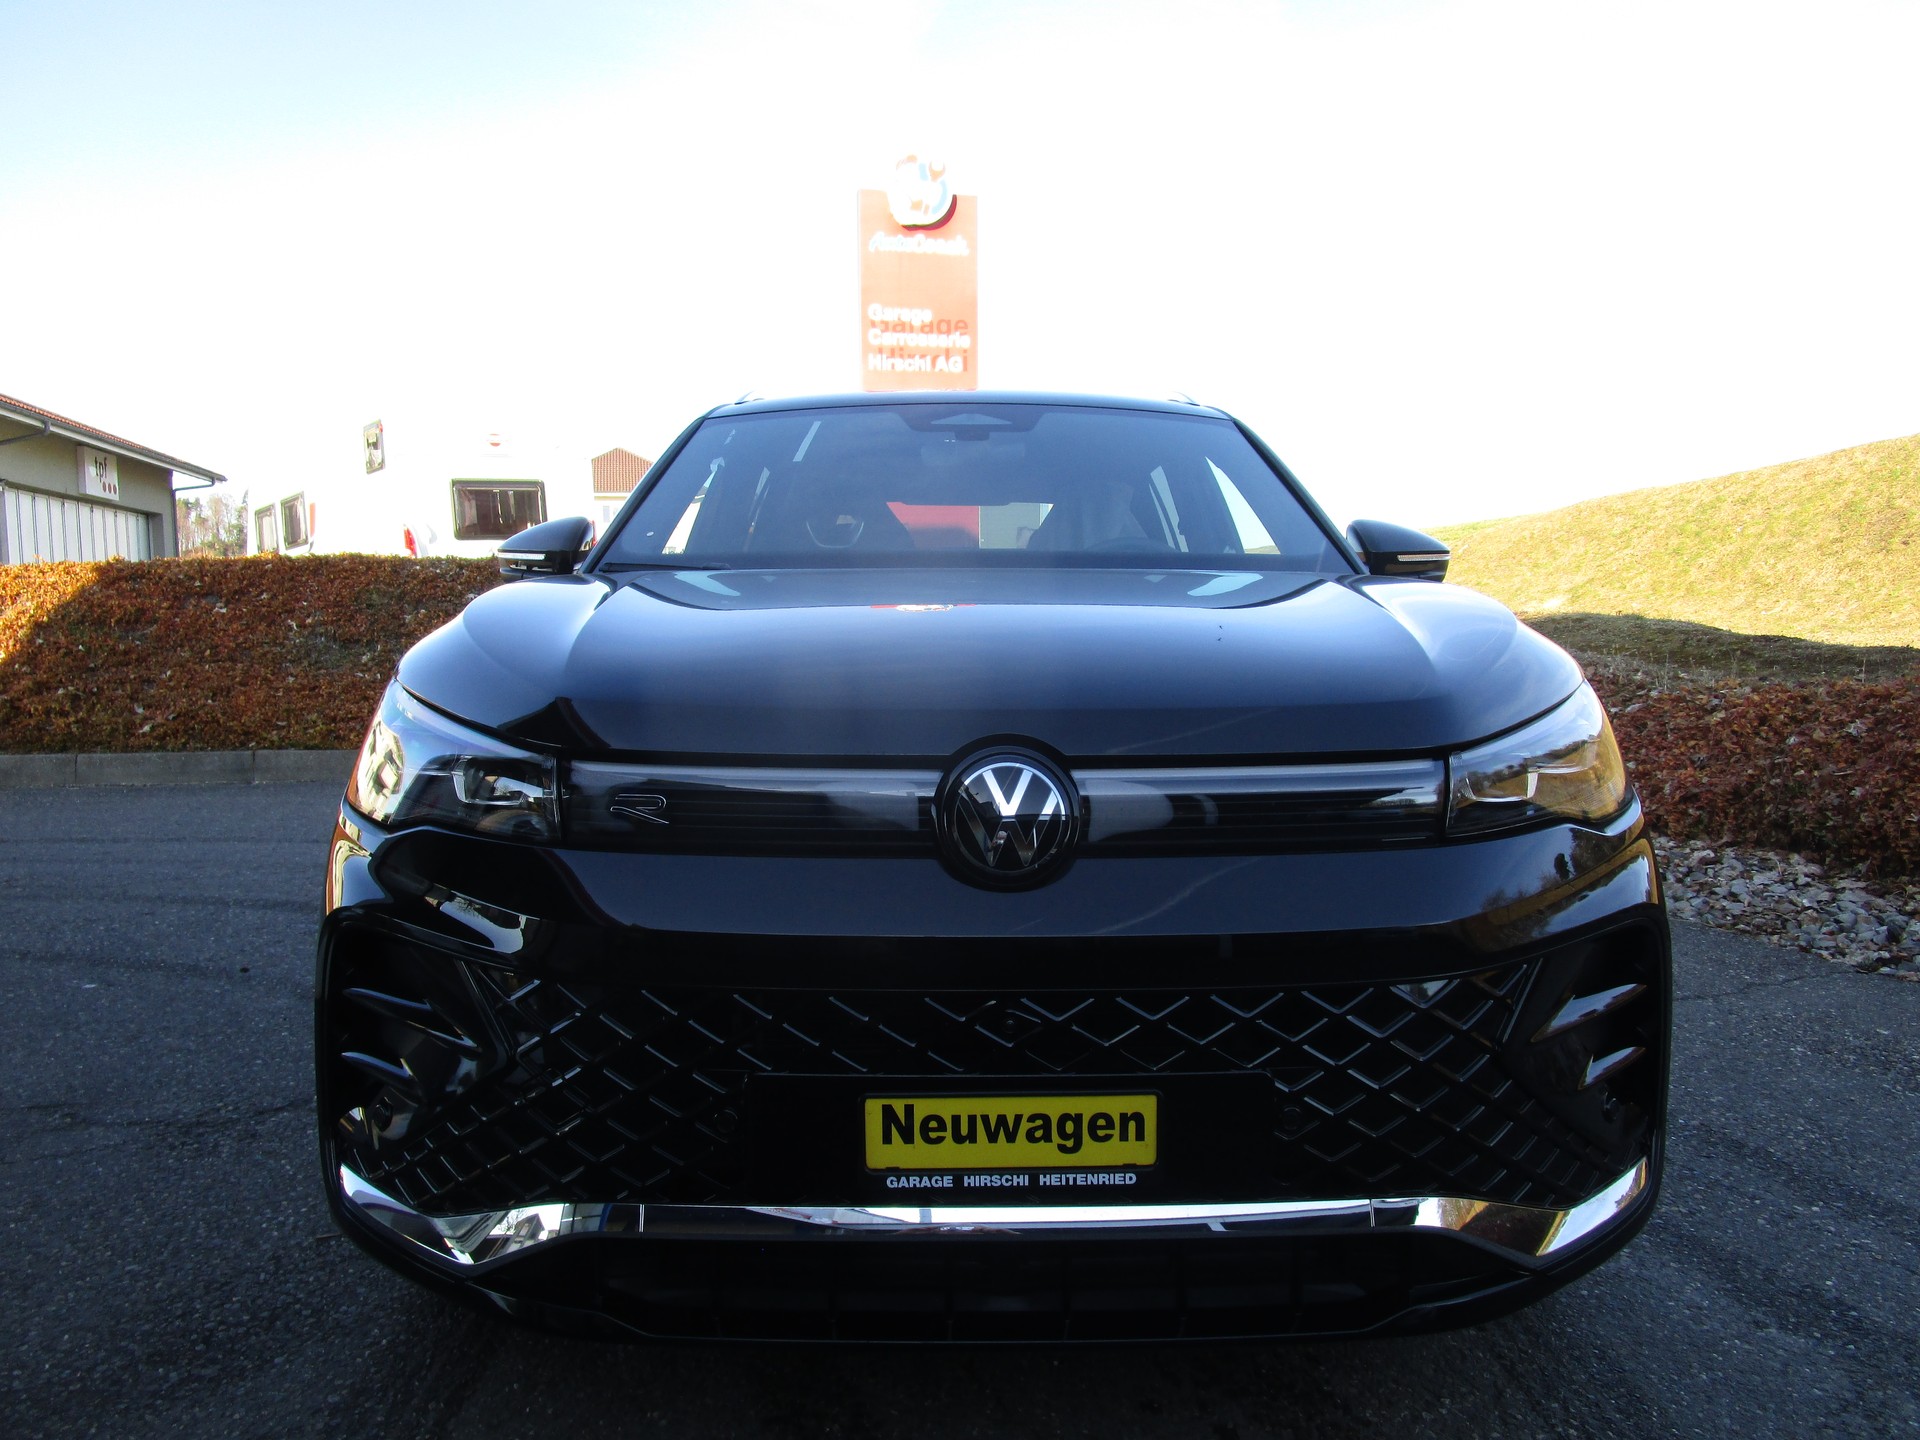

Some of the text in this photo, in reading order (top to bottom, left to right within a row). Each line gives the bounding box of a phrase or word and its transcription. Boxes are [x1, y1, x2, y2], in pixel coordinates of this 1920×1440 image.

[934, 355, 963, 372] AG
[881, 1103, 1146, 1154] Neuwagen
[886, 1173, 1137, 1188] GARAGE HIRSCHI HEITENRIED
